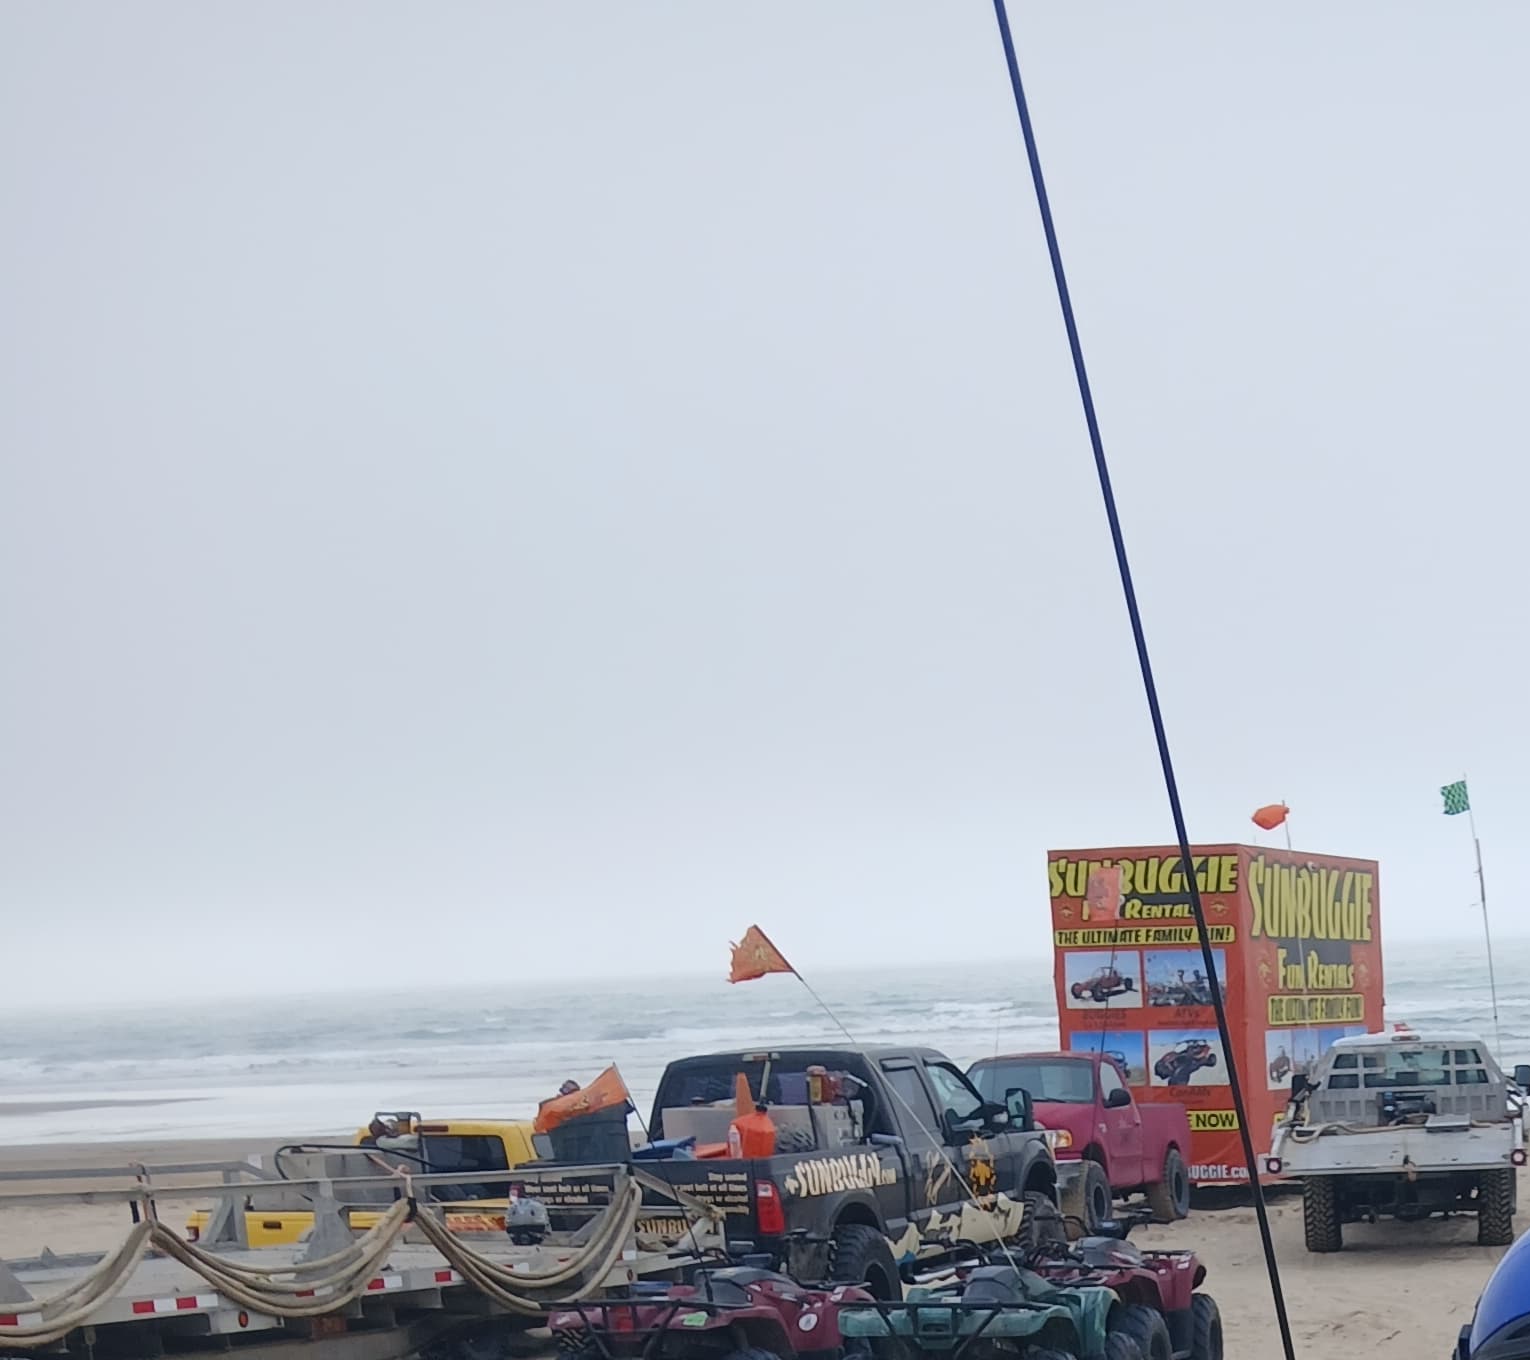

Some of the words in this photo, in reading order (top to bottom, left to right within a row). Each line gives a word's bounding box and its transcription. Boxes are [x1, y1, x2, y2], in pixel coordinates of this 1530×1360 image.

[1249, 855, 1373, 941] SUNBUGGIE
[1058, 931, 1079, 945] THE
[1082, 929, 1142, 944] ULTIMATE
[1145, 927, 1194, 942] FAMILY
[1196, 1113, 1235, 1128] NOW
